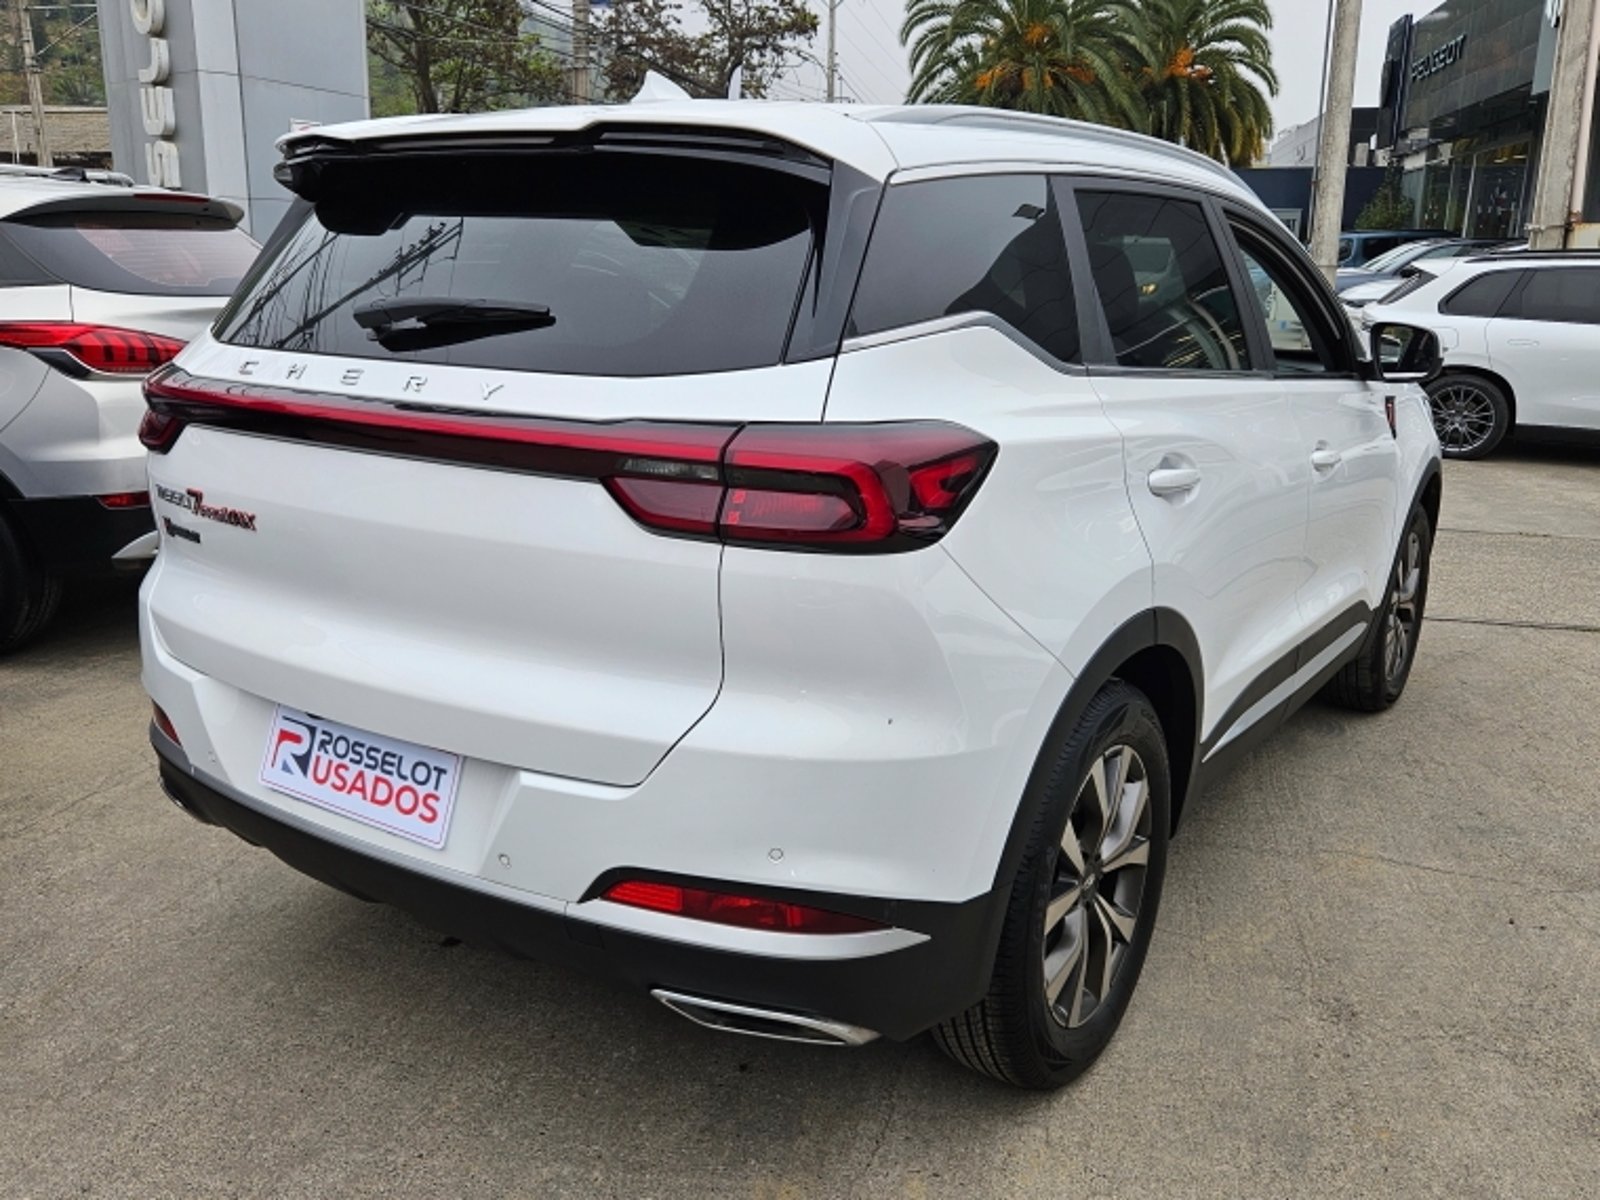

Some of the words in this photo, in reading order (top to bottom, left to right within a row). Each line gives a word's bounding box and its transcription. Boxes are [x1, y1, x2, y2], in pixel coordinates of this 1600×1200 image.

[1412, 33, 1466, 81] PEUGEOT
[239, 360, 505, 401] CHERY
[317, 729, 448, 792] ROSSELOT
[312, 754, 441, 824] USADOS
